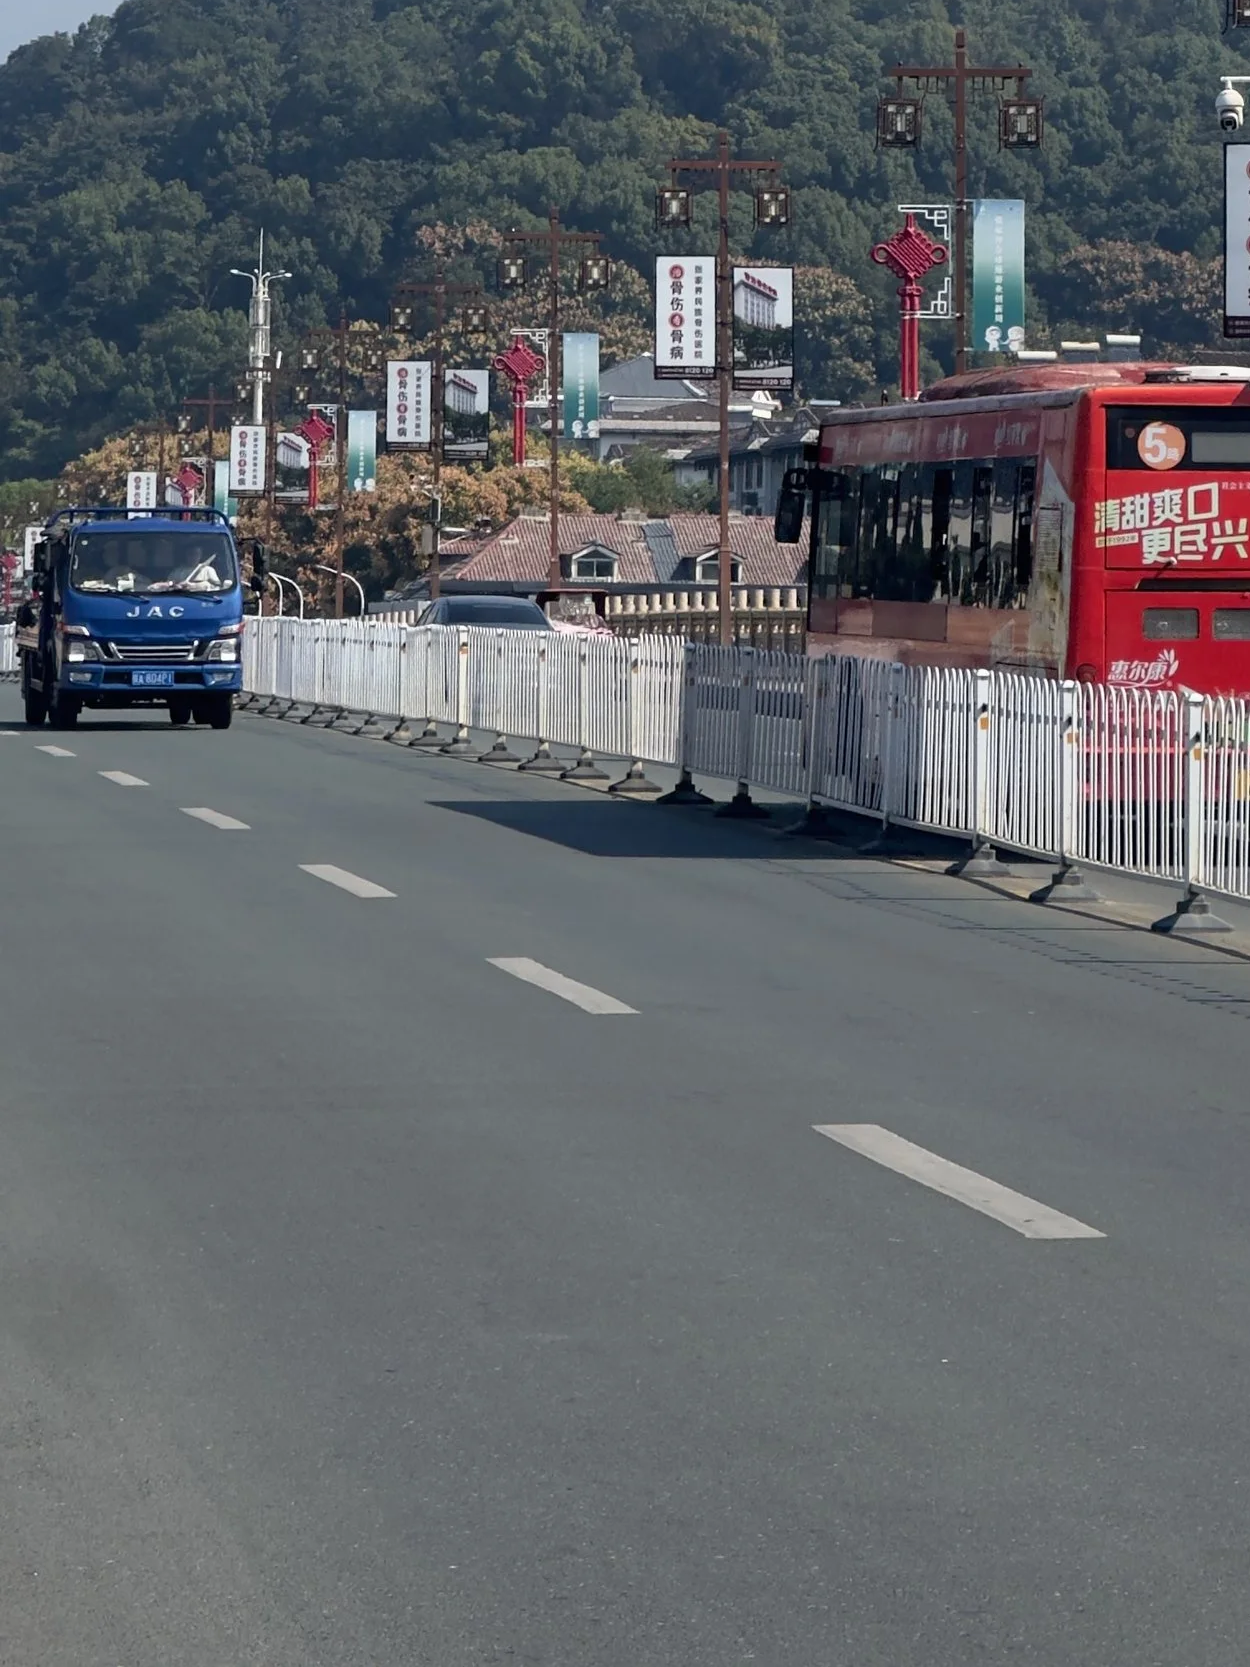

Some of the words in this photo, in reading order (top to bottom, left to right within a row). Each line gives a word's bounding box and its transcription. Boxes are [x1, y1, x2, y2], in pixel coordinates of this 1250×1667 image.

[1094, 482, 1219, 534] 清甜爽口
[126, 605, 184, 618] JAC
[1107, 659, 1168, 681] 惠尔康
